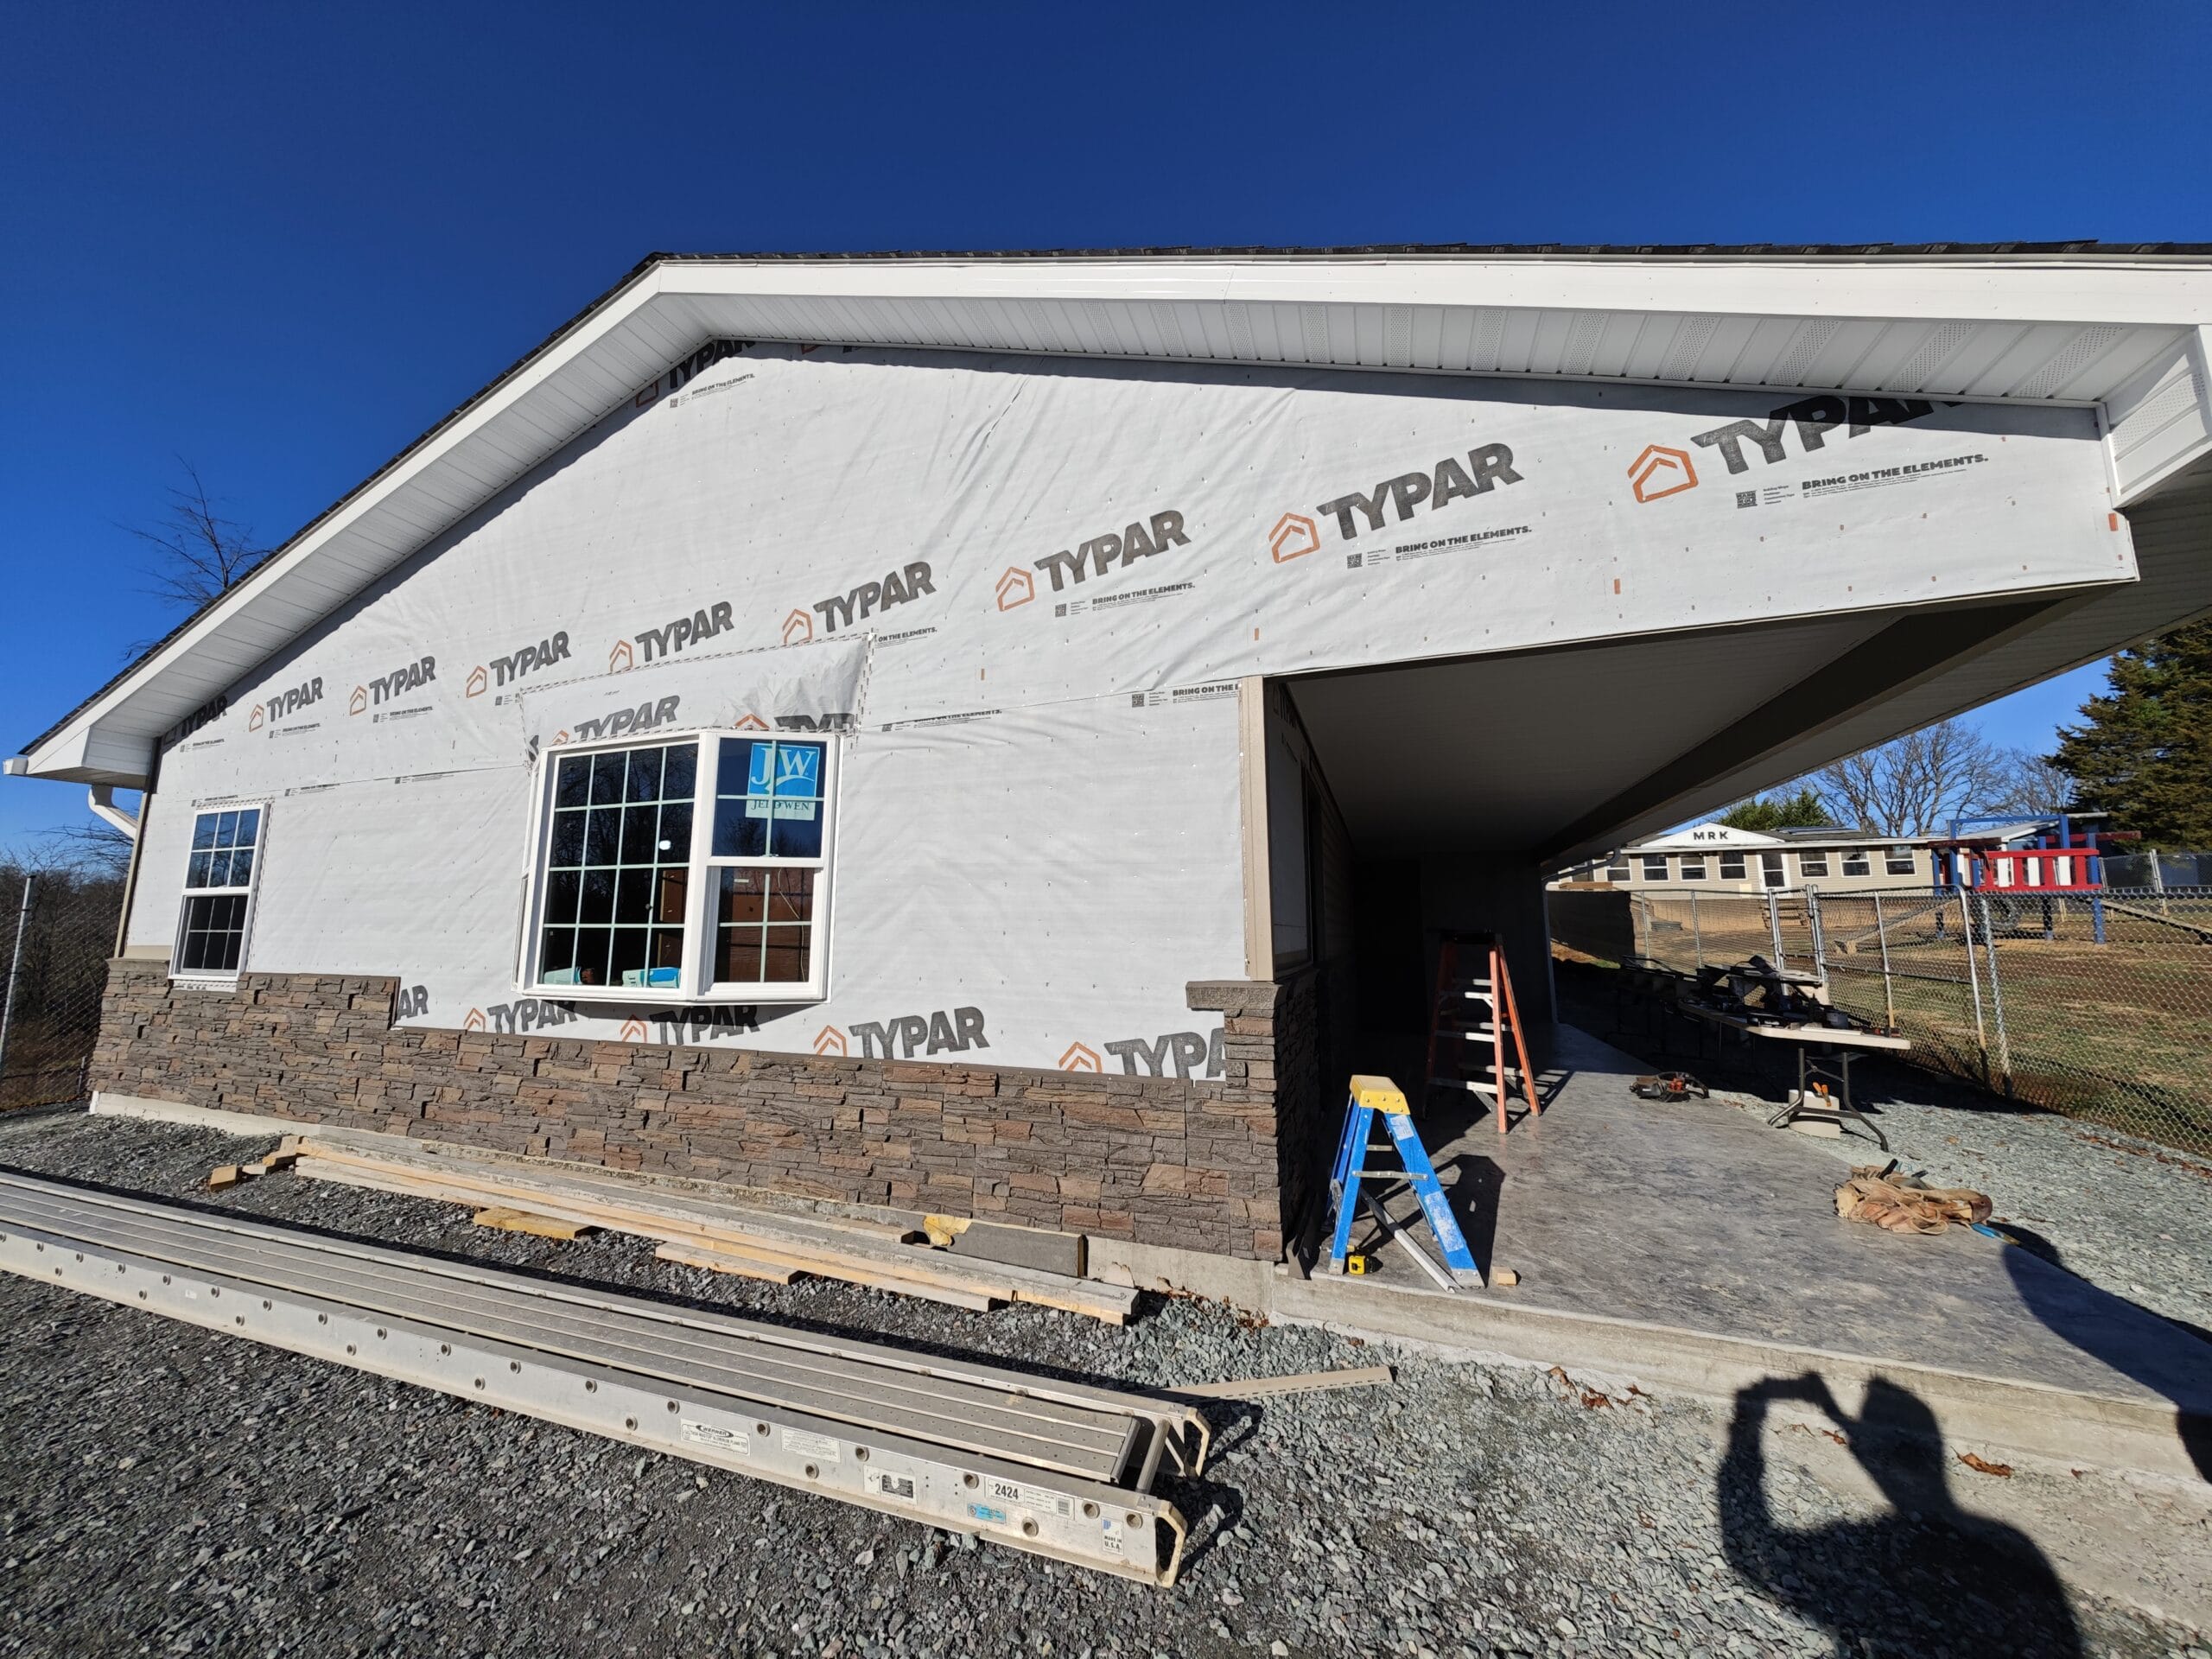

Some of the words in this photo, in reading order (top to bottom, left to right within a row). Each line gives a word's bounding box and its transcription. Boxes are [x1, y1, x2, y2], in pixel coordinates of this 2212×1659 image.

[1316, 442, 1525, 541] TYPAR
[1802, 476, 1847, 490] BRING
[1848, 472, 1870, 482] ON
[1872, 467, 1900, 479] THE
[1903, 454, 1989, 474] ELEMENTS.
[1033, 510, 1192, 592] TYPAR
[1395, 541, 1428, 554] BRING
[1430, 539, 1446, 549] ON
[1447, 535, 1469, 546] THE
[1470, 525, 1533, 542] ELEMENTS.
[813, 561, 937, 634] TYPAR
[1092, 594, 1117, 605] BRING
[1132, 588, 1147, 597] THE
[1147, 582, 1196, 594] ELEMENTS.
[635, 601, 735, 663] TYPAR
[369, 656, 436, 706] TYPAR
[489, 631, 572, 687] TYPAR
[267, 677, 324, 722] TYPAR
[1173, 687, 1199, 696] BRING
[1201, 685, 1215, 694] ON
[1216, 683, 1234, 692] THE
[574, 695, 680, 740] TYPAR
[486, 999, 578, 1034] TYPAR
[649, 1004, 761, 1046] TYPAR
[849, 1006, 990, 1059] TYPAR
[702, 1427, 728, 1436] WERNER
[995, 1483, 1020, 1500] 2424
